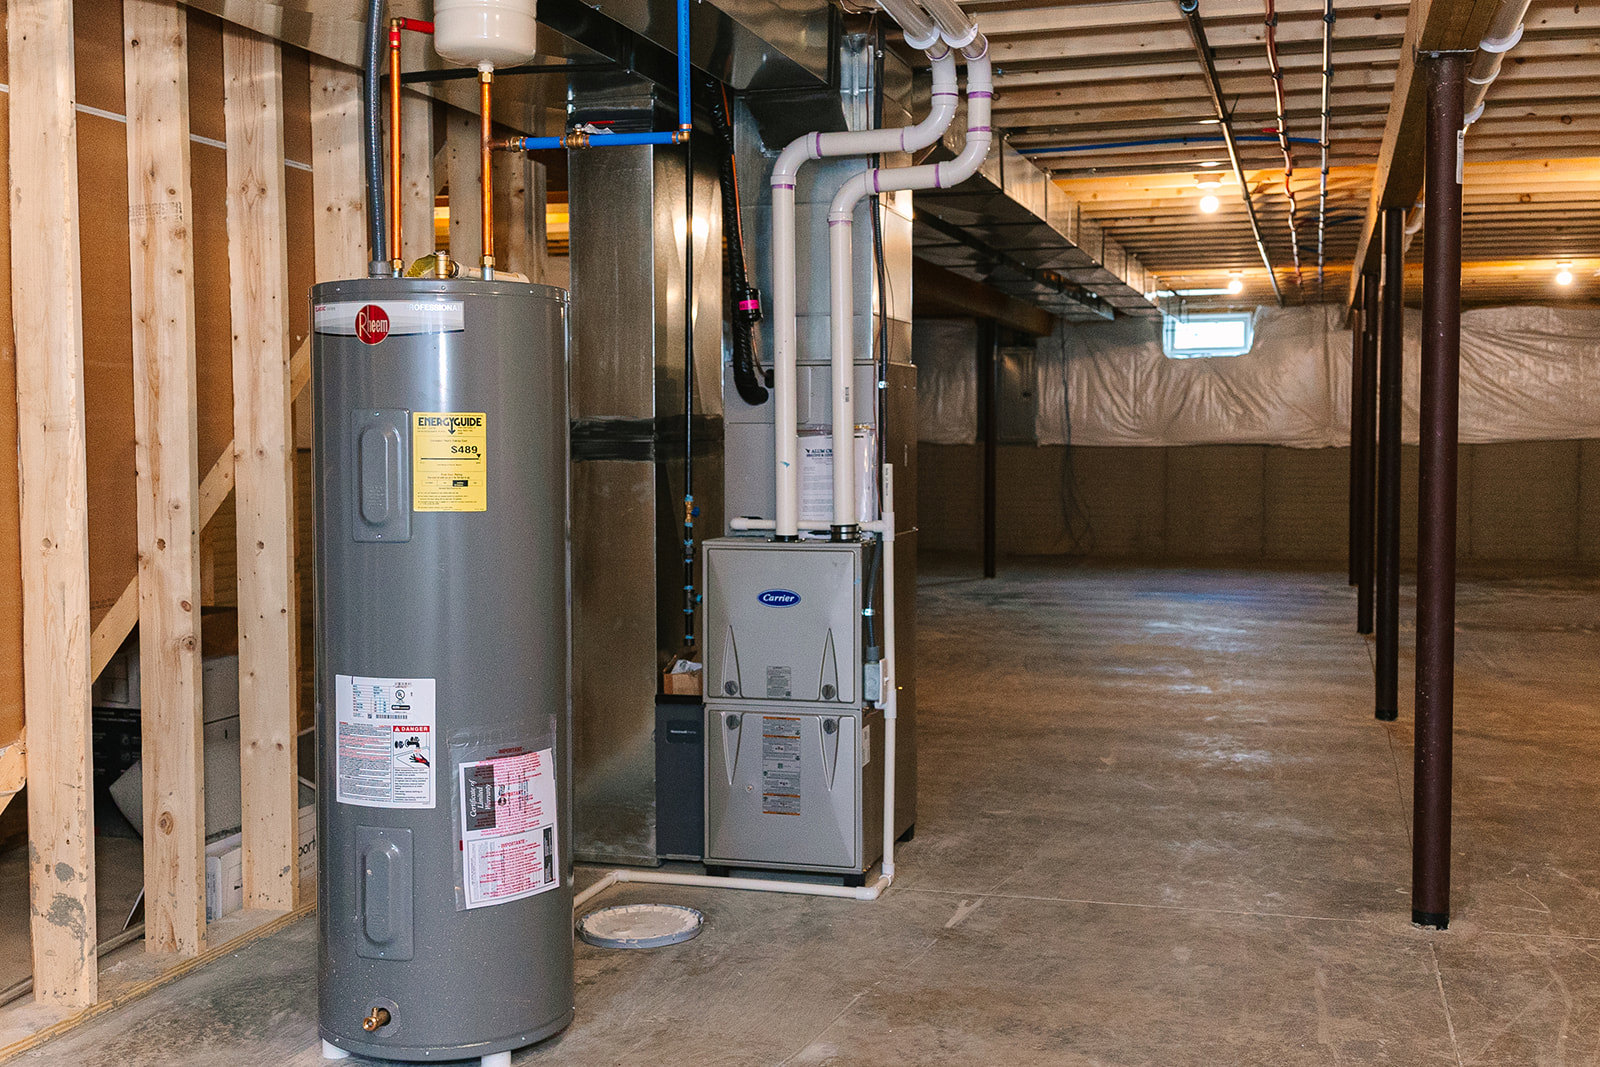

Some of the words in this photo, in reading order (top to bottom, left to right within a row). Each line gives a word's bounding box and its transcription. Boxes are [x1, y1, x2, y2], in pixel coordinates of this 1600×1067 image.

[408, 303, 460, 312] ROFESSIONA
[358, 305, 389, 338] Rheem
[418, 416, 482, 427] ENERGYGUIDE
[762, 593, 795, 602] Carrier
